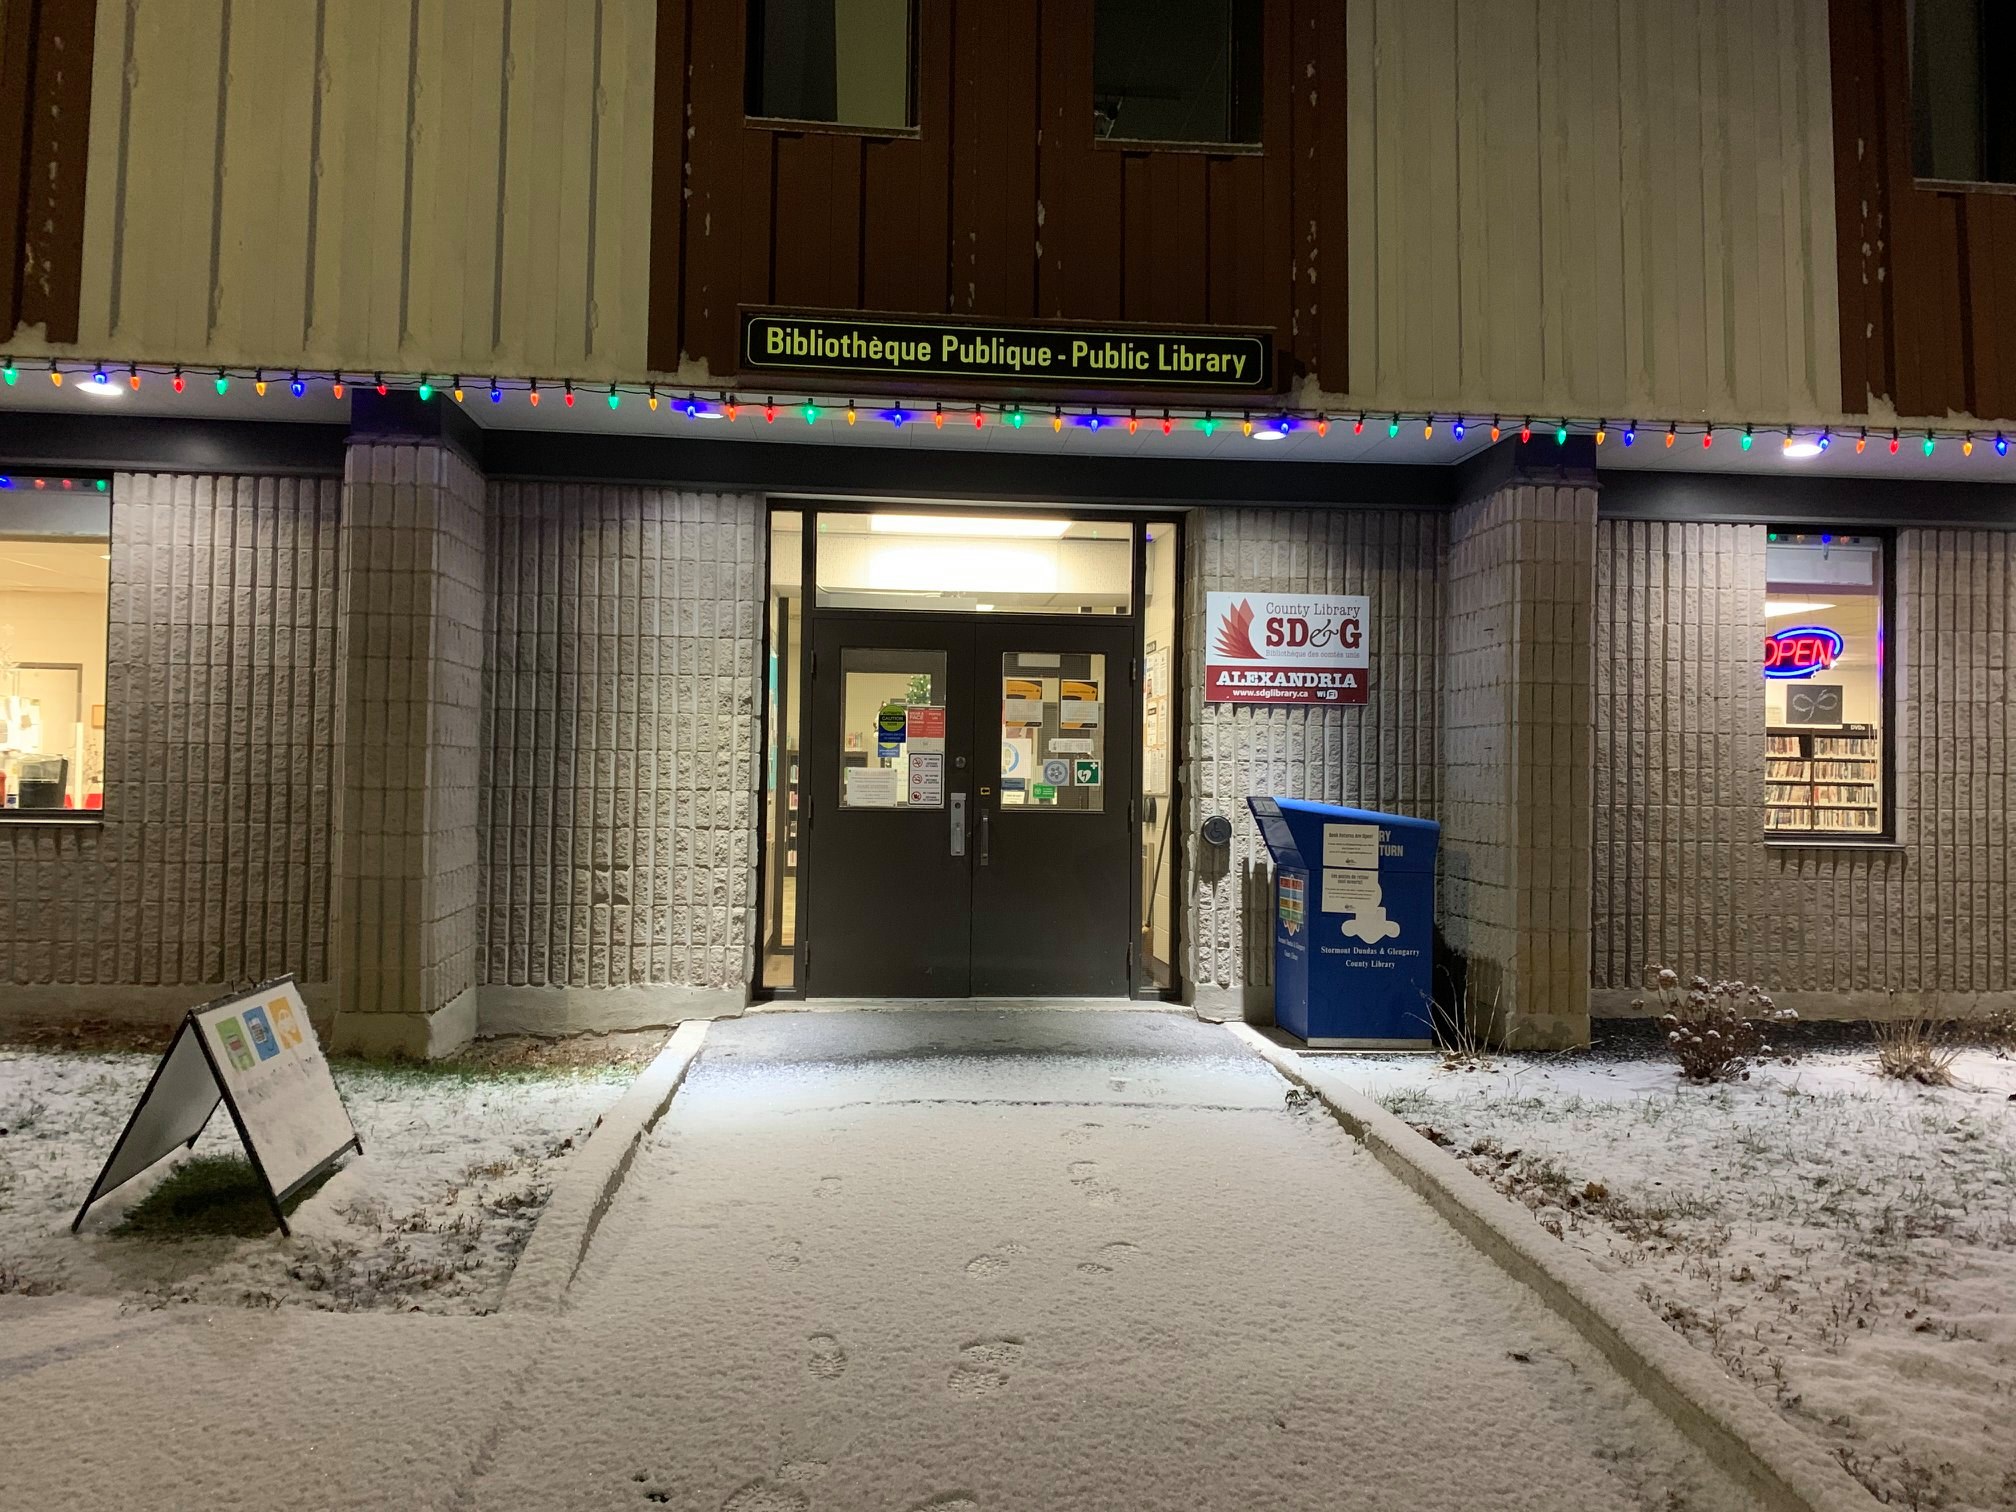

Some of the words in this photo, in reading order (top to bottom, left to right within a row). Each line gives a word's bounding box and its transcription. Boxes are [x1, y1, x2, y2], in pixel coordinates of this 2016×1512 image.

[766, 326, 932, 367] Bibliothèque
[941, 334, 1052, 371] Publique
[1072, 340, 1149, 371] Public
[1158, 344, 1246, 379] Library
[1265, 602, 1310, 618] County
[1313, 603, 1361, 619] Library
[1307, 650, 1320, 658] des
[1216, 671, 1358, 688] ALEXANDRIA
[1232, 688, 1309, 699] www.sdglibrary.ca
[1378, 844, 1404, 857] TURN
[1320, 946, 1351, 955] Stormont
[1353, 946, 1378, 955] Dundas
[1379, 947, 1385, 955] &
[1387, 947, 1420, 957] Glengarry
[1345, 959, 1369, 969] County
[1371, 960, 1396, 969] Library
